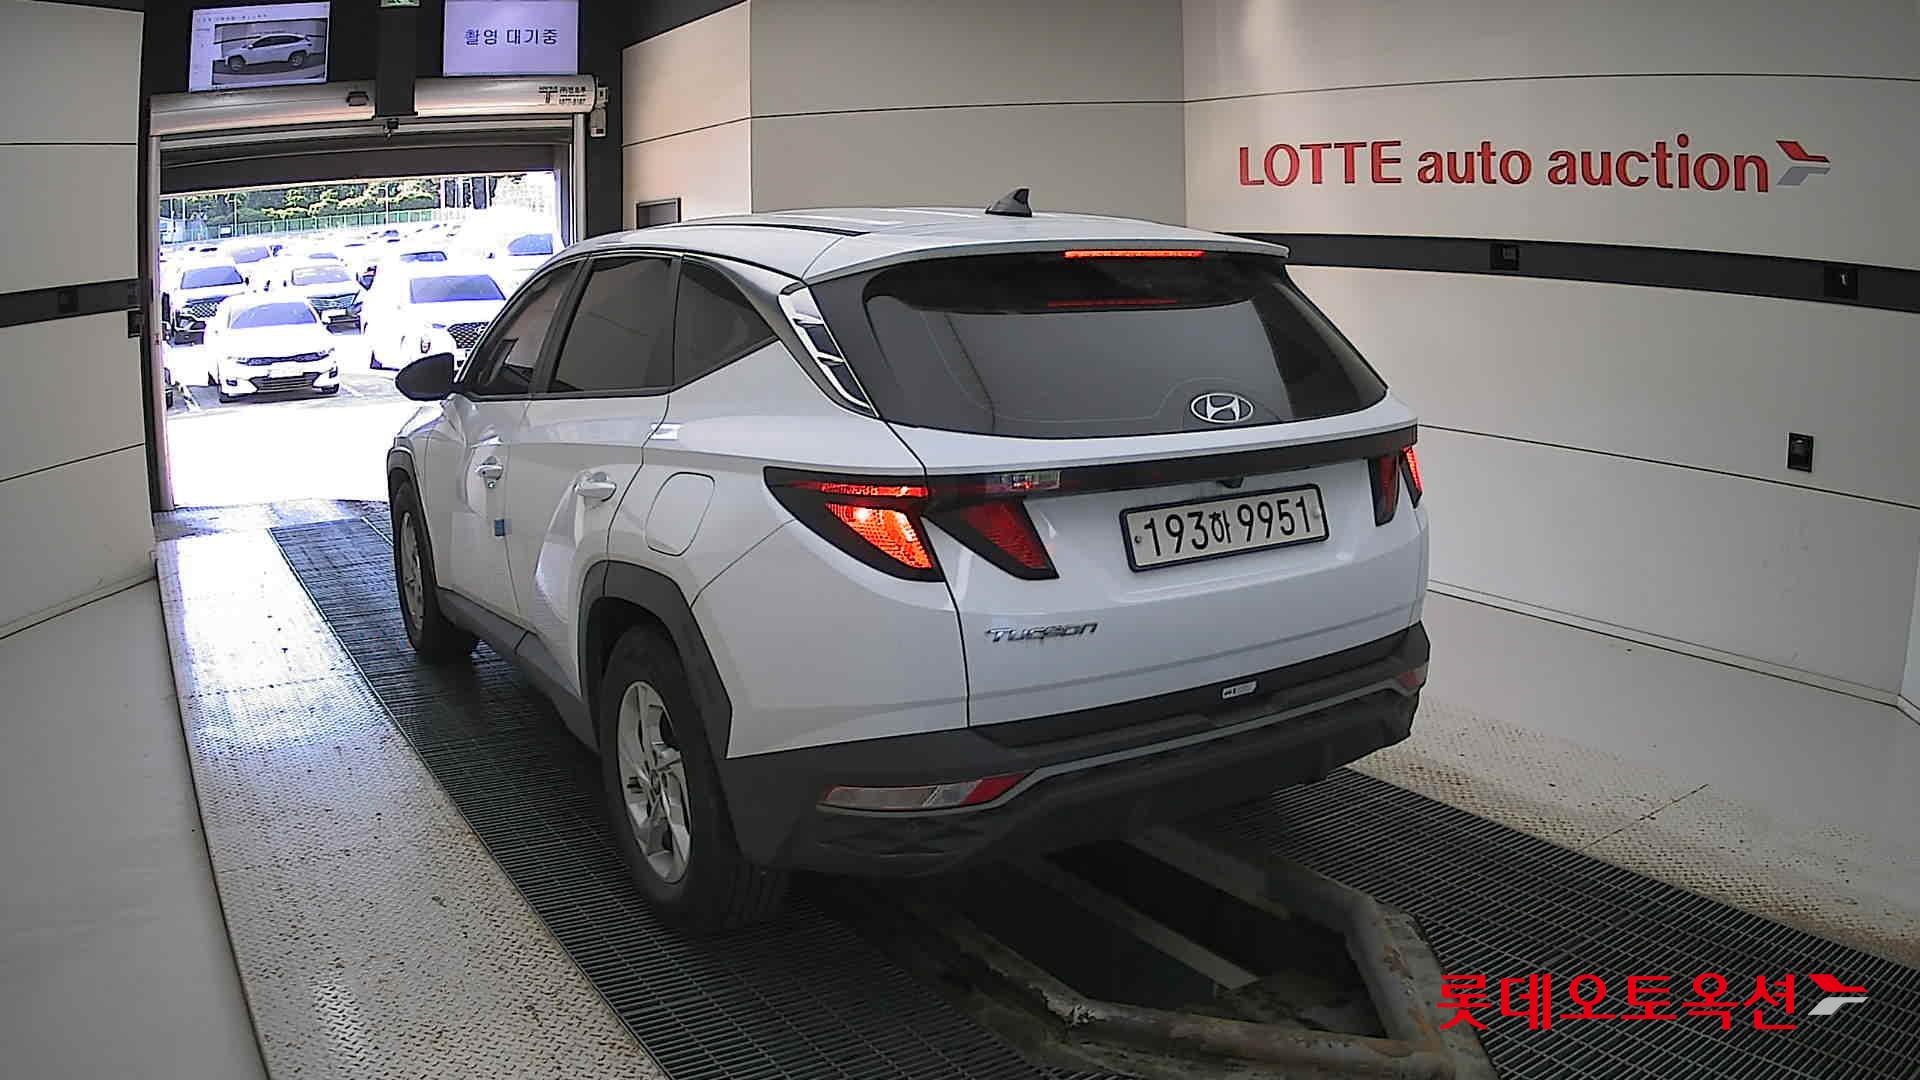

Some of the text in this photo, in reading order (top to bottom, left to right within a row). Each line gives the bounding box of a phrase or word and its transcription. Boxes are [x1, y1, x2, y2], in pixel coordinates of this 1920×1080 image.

[464, 28, 559, 46] 촬영 대기중
[1239, 134, 1770, 193] LOTTE auto auction
[1144, 496, 1311, 557] 193하 9951
